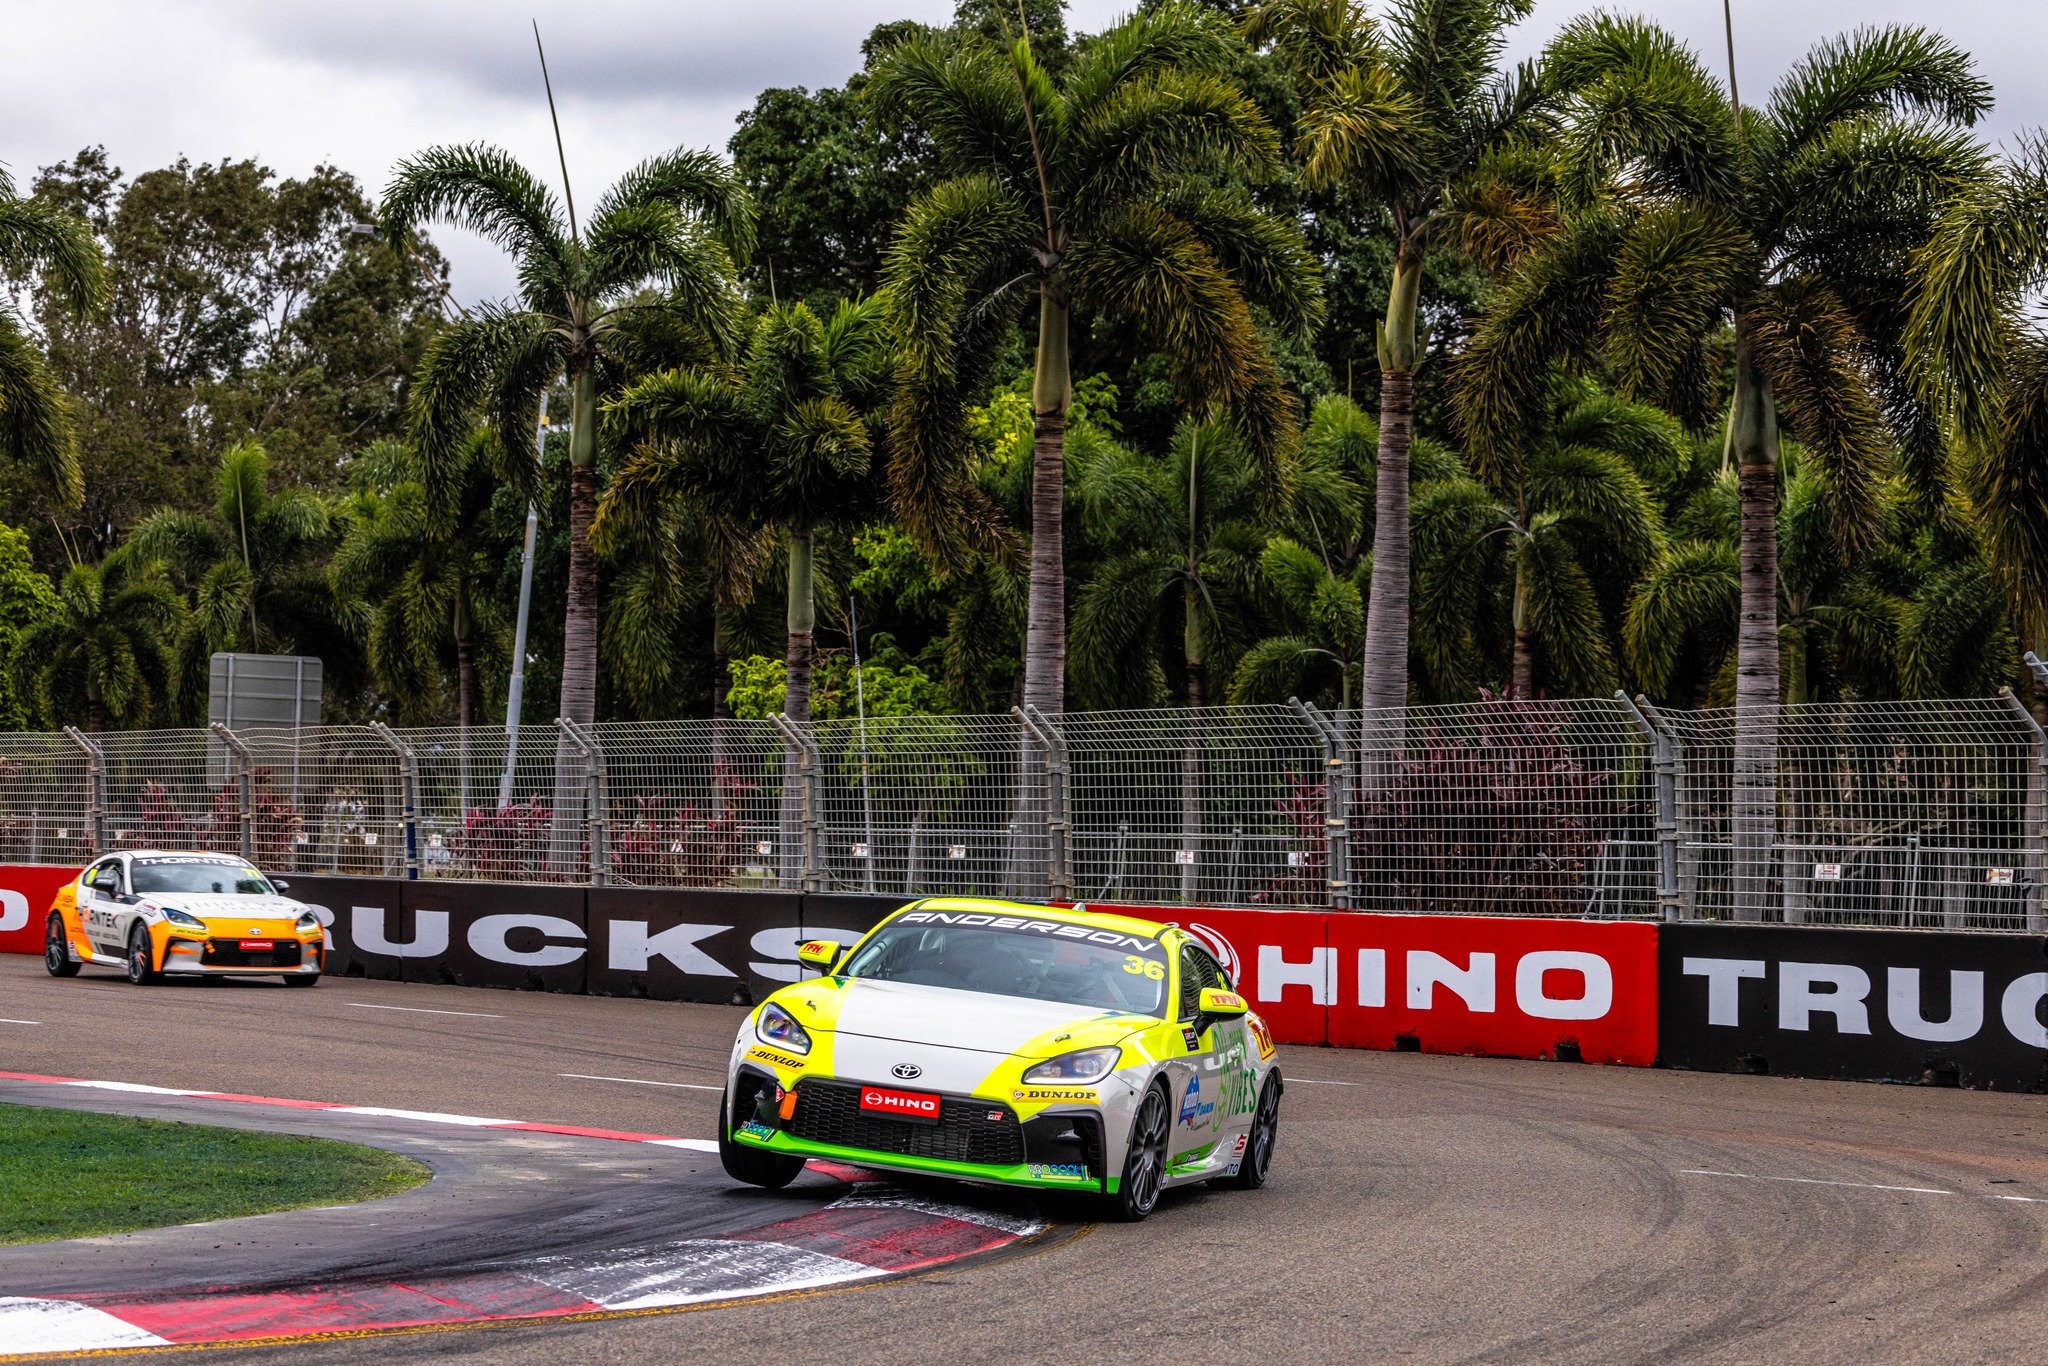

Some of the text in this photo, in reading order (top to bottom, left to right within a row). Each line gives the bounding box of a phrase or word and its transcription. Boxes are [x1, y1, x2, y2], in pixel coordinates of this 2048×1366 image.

[138, 857, 248, 868] THORNTON
[897, 912, 1158, 952] ANDERSON
[1122, 955, 1165, 981] 36
[1257, 944, 1613, 1020] HINO
[754, 1050, 805, 1069] DUNLOP
[884, 1096, 936, 1111] HINO
[1028, 1090, 1097, 1100] DUNLOP
